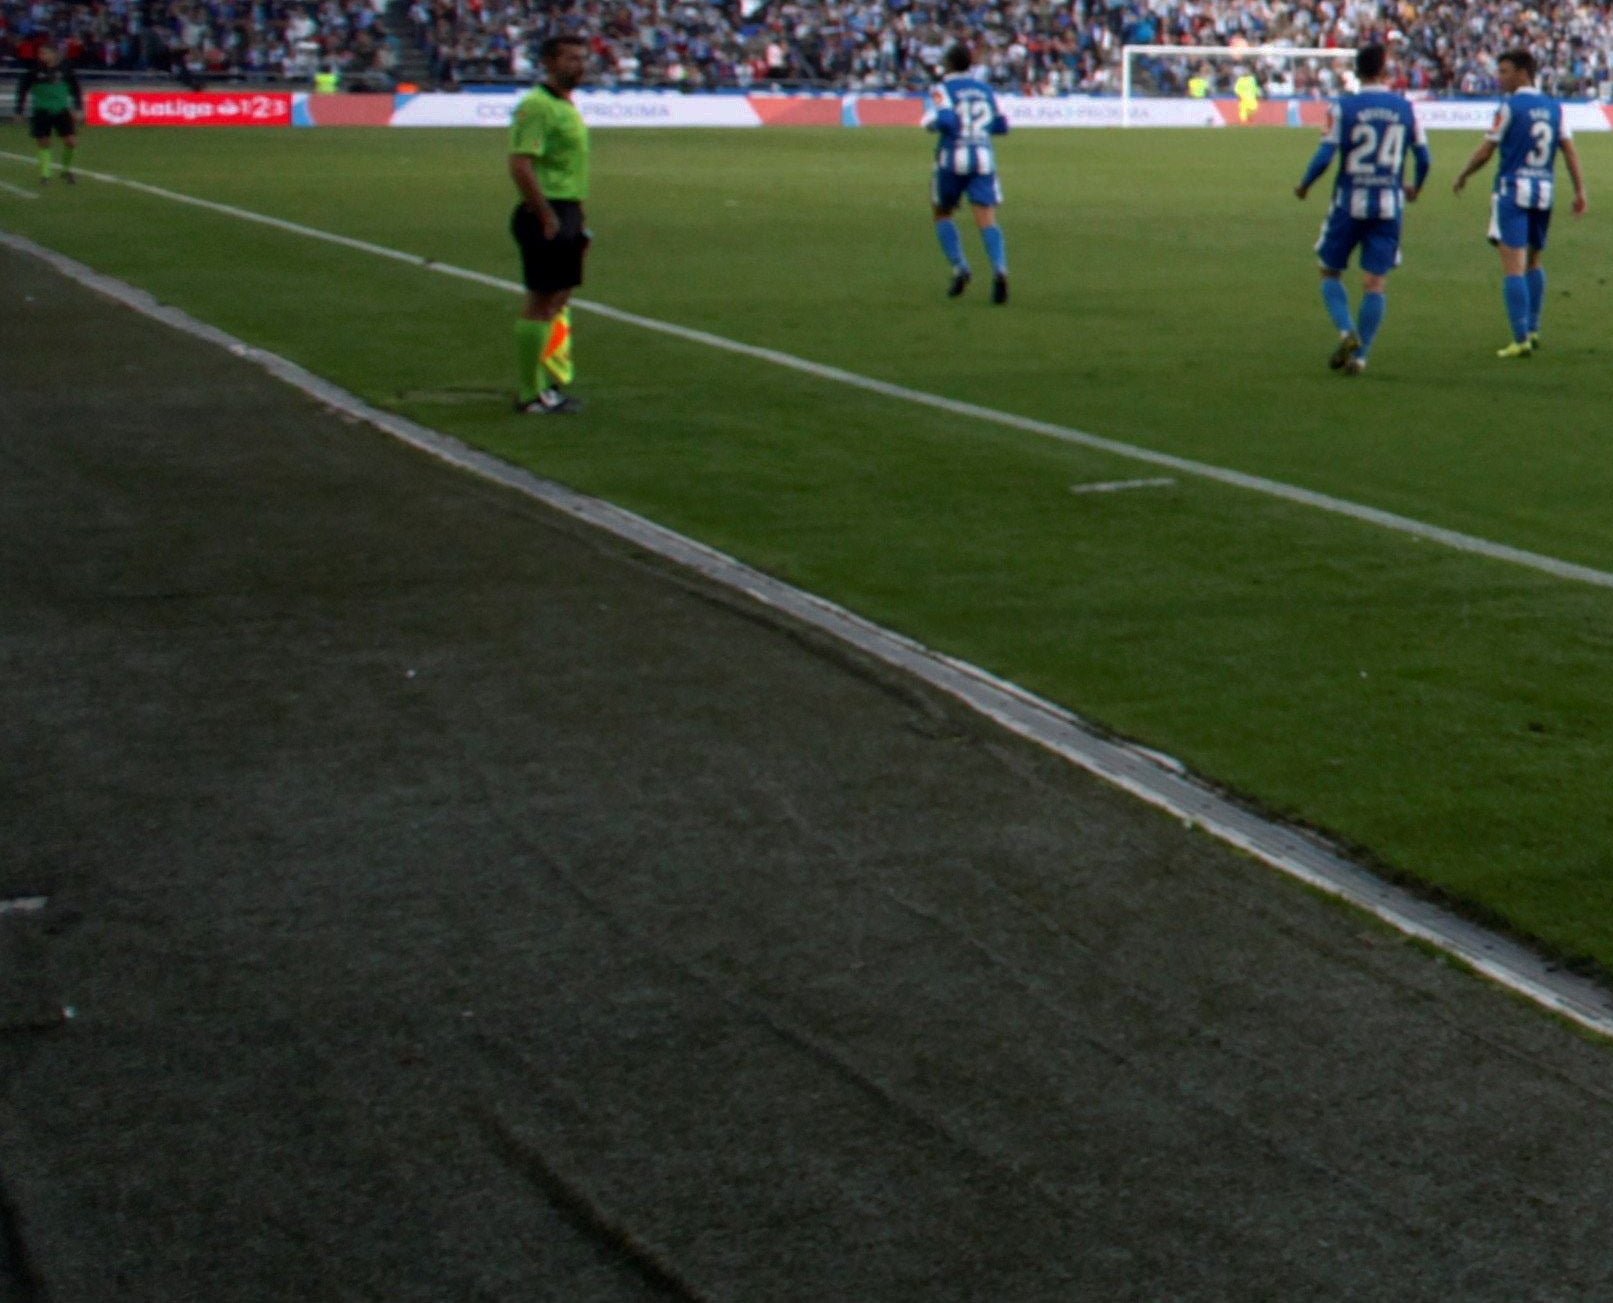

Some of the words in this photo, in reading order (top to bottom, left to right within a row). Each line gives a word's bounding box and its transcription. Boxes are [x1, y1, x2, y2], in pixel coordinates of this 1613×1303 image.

[140, 98, 213, 119] LaLiga
[955, 99, 993, 138] 12
[1345, 122, 1406, 175] 24
[1525, 121, 1553, 168] 3
